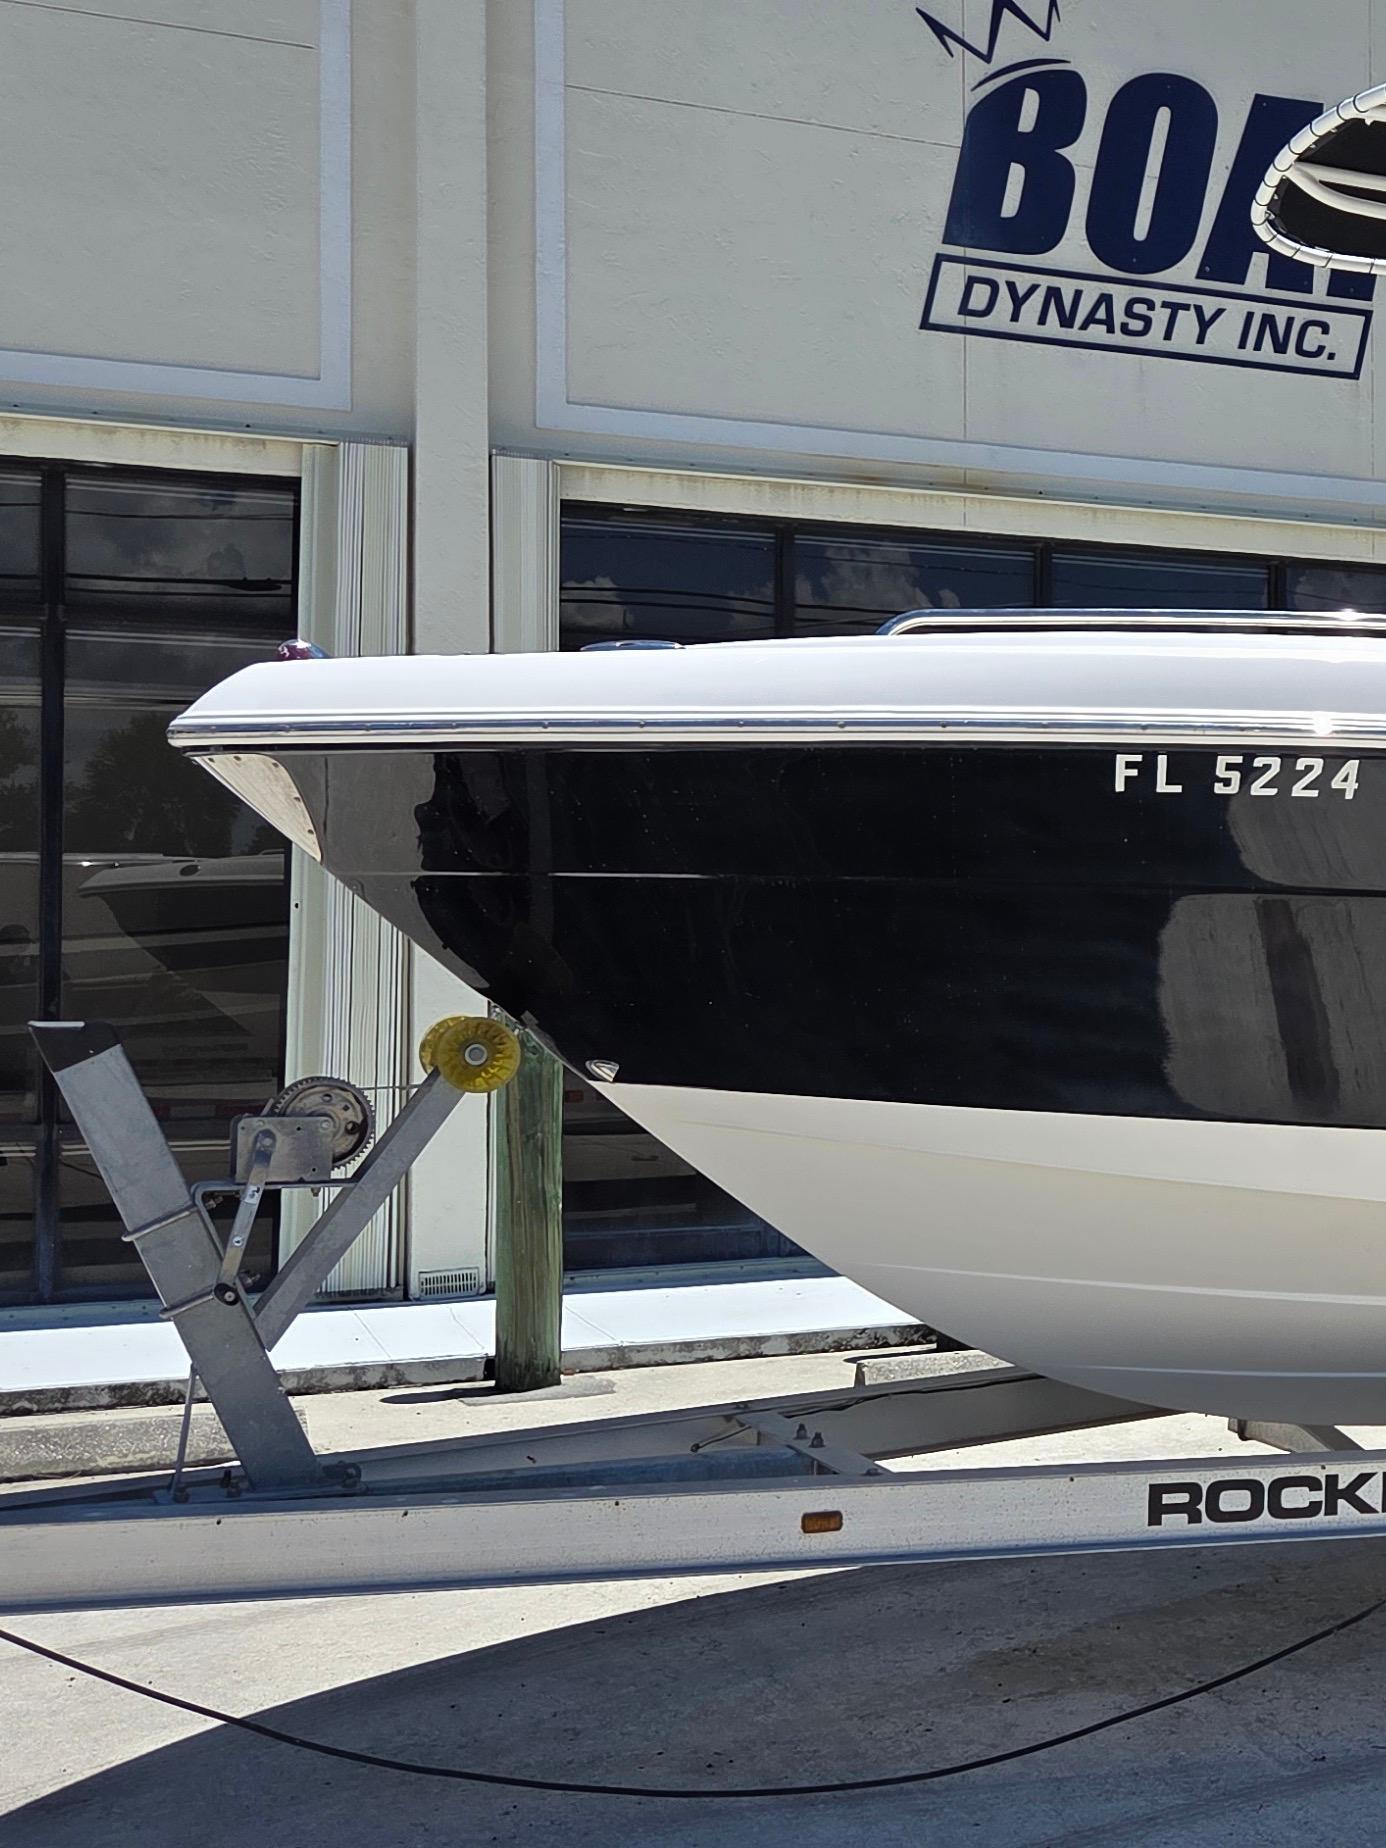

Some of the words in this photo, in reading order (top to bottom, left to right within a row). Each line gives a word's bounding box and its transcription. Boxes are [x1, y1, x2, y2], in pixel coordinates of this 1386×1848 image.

[942, 69, 1375, 300] BOA
[957, 275, 1226, 345] DYNASTY
[1237, 310, 1338, 361] INC.
[1115, 754, 1183, 793] FL
[1213, 755, 1360, 799] 5224
